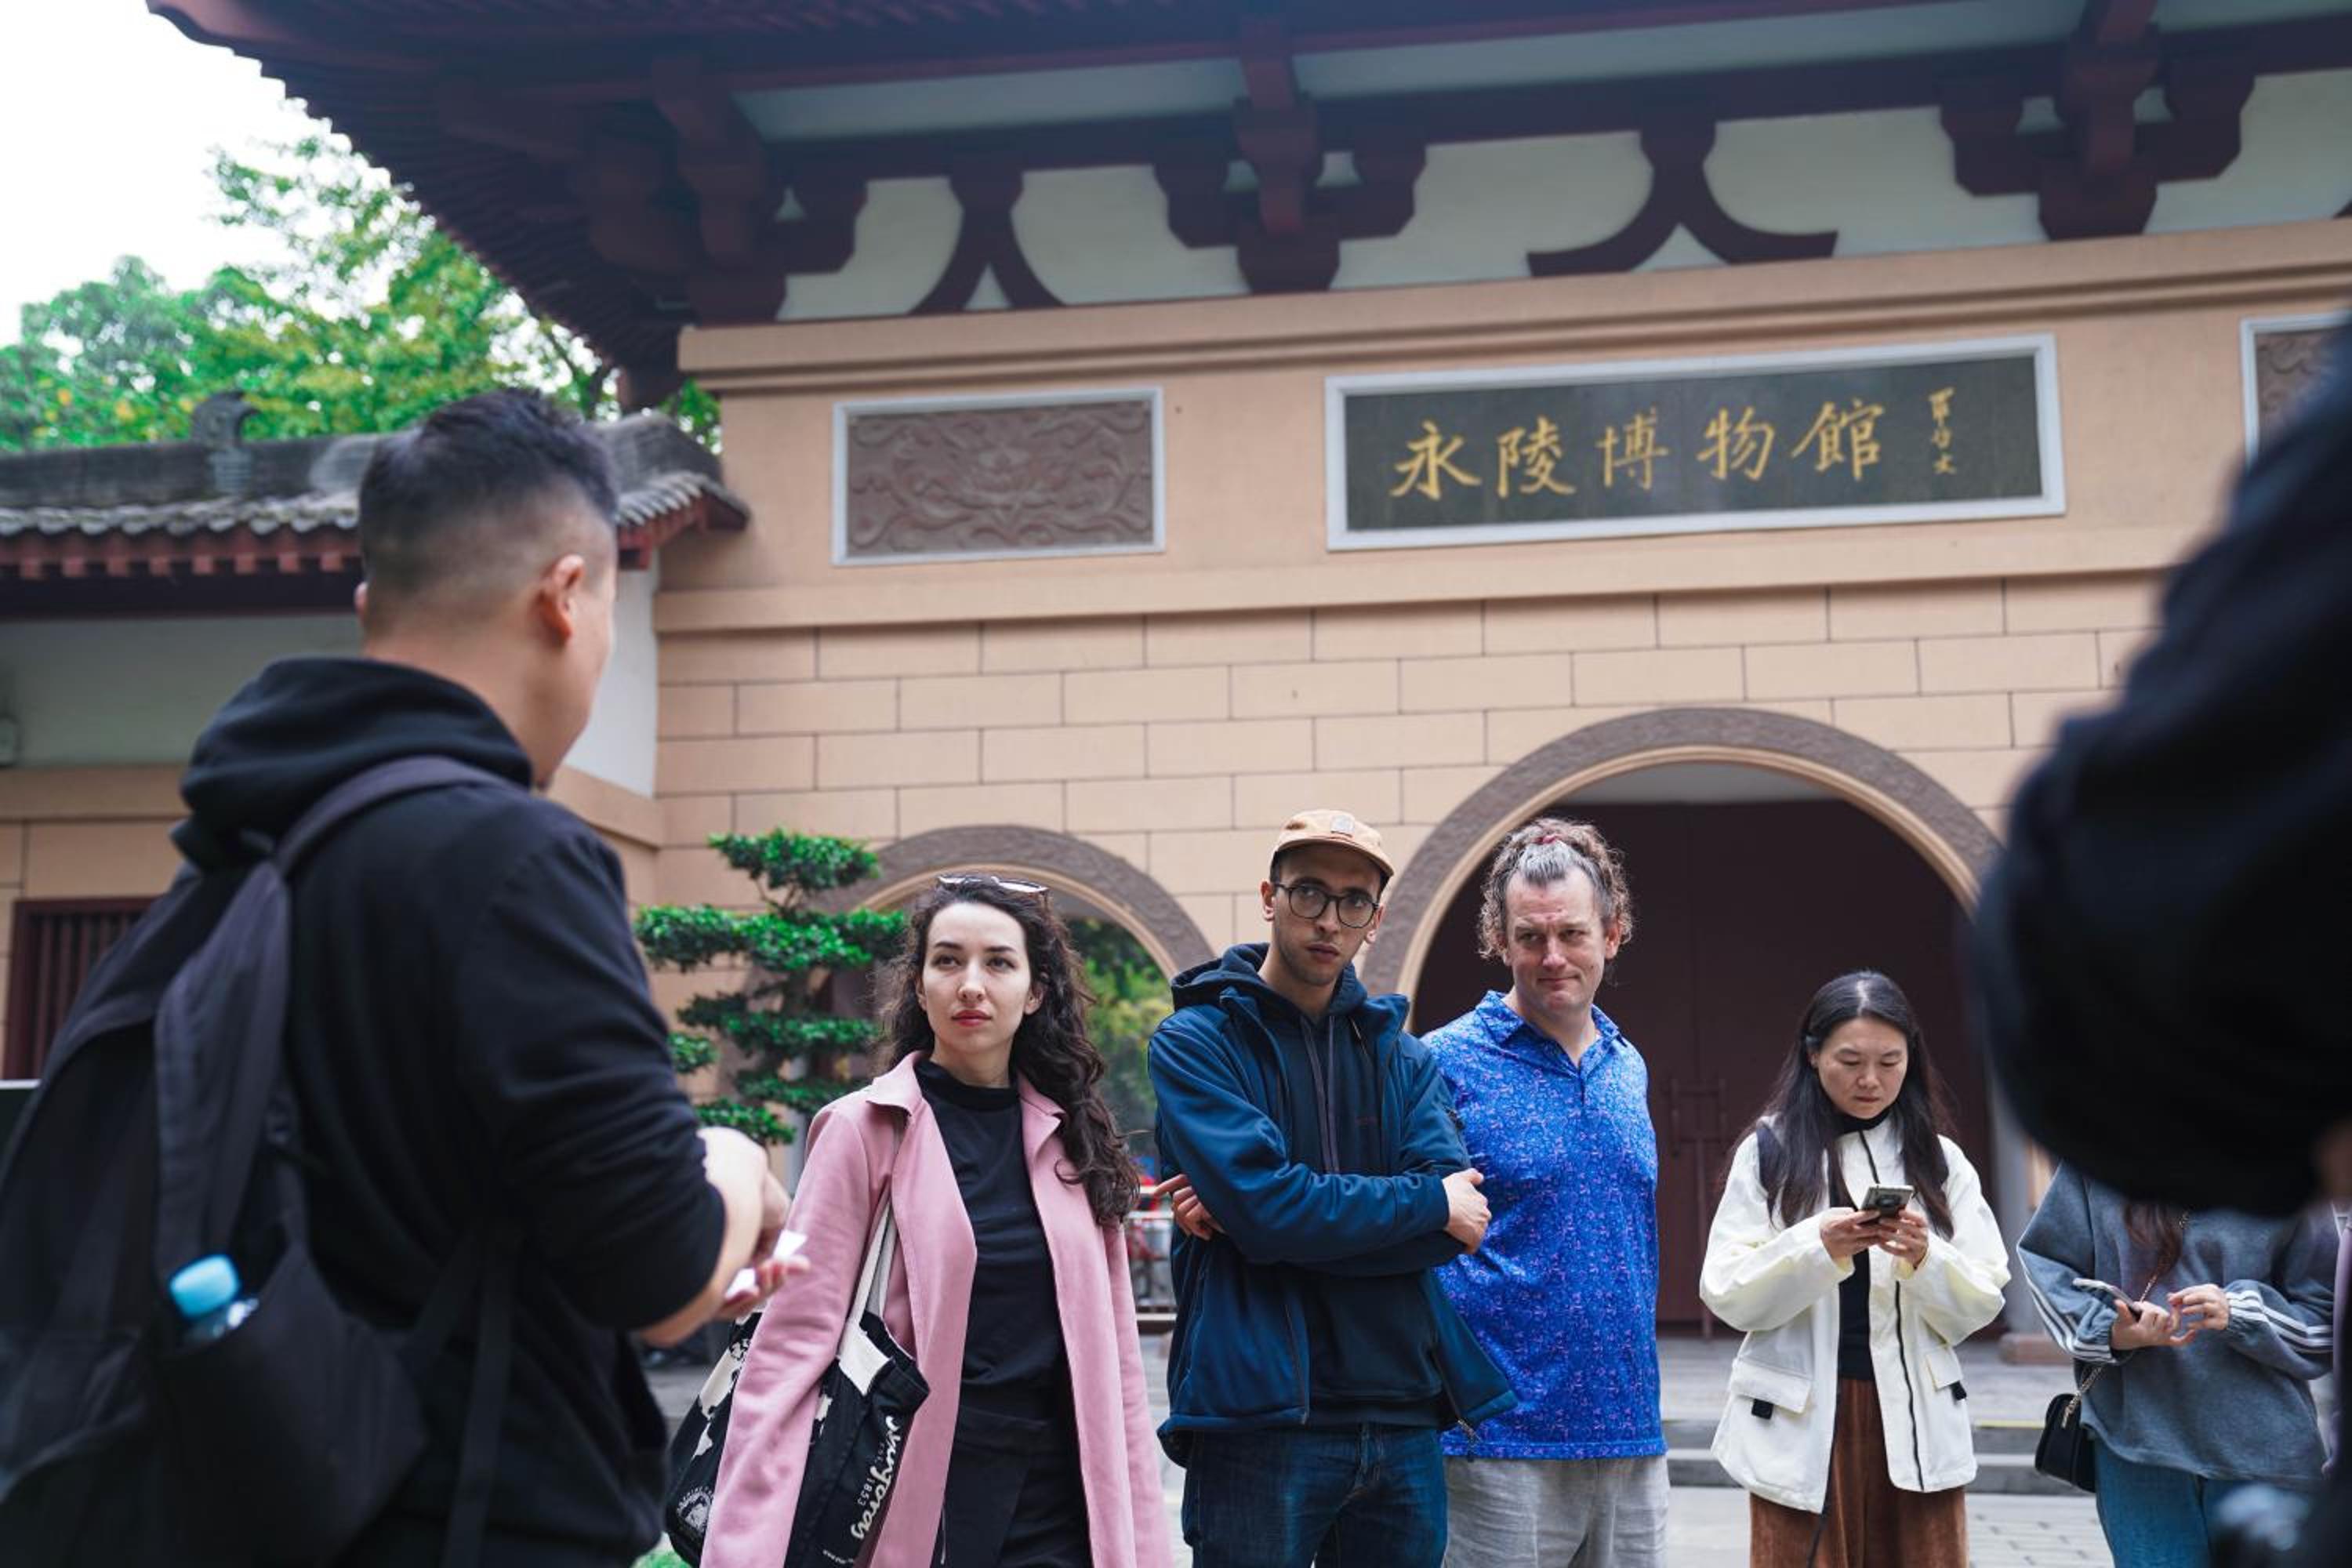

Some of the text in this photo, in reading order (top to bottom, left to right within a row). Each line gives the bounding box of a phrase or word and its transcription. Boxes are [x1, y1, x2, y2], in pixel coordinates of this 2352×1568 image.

[1390, 399, 1886, 502] 永陵博物館
[857, 1477, 876, 1506] 1853
